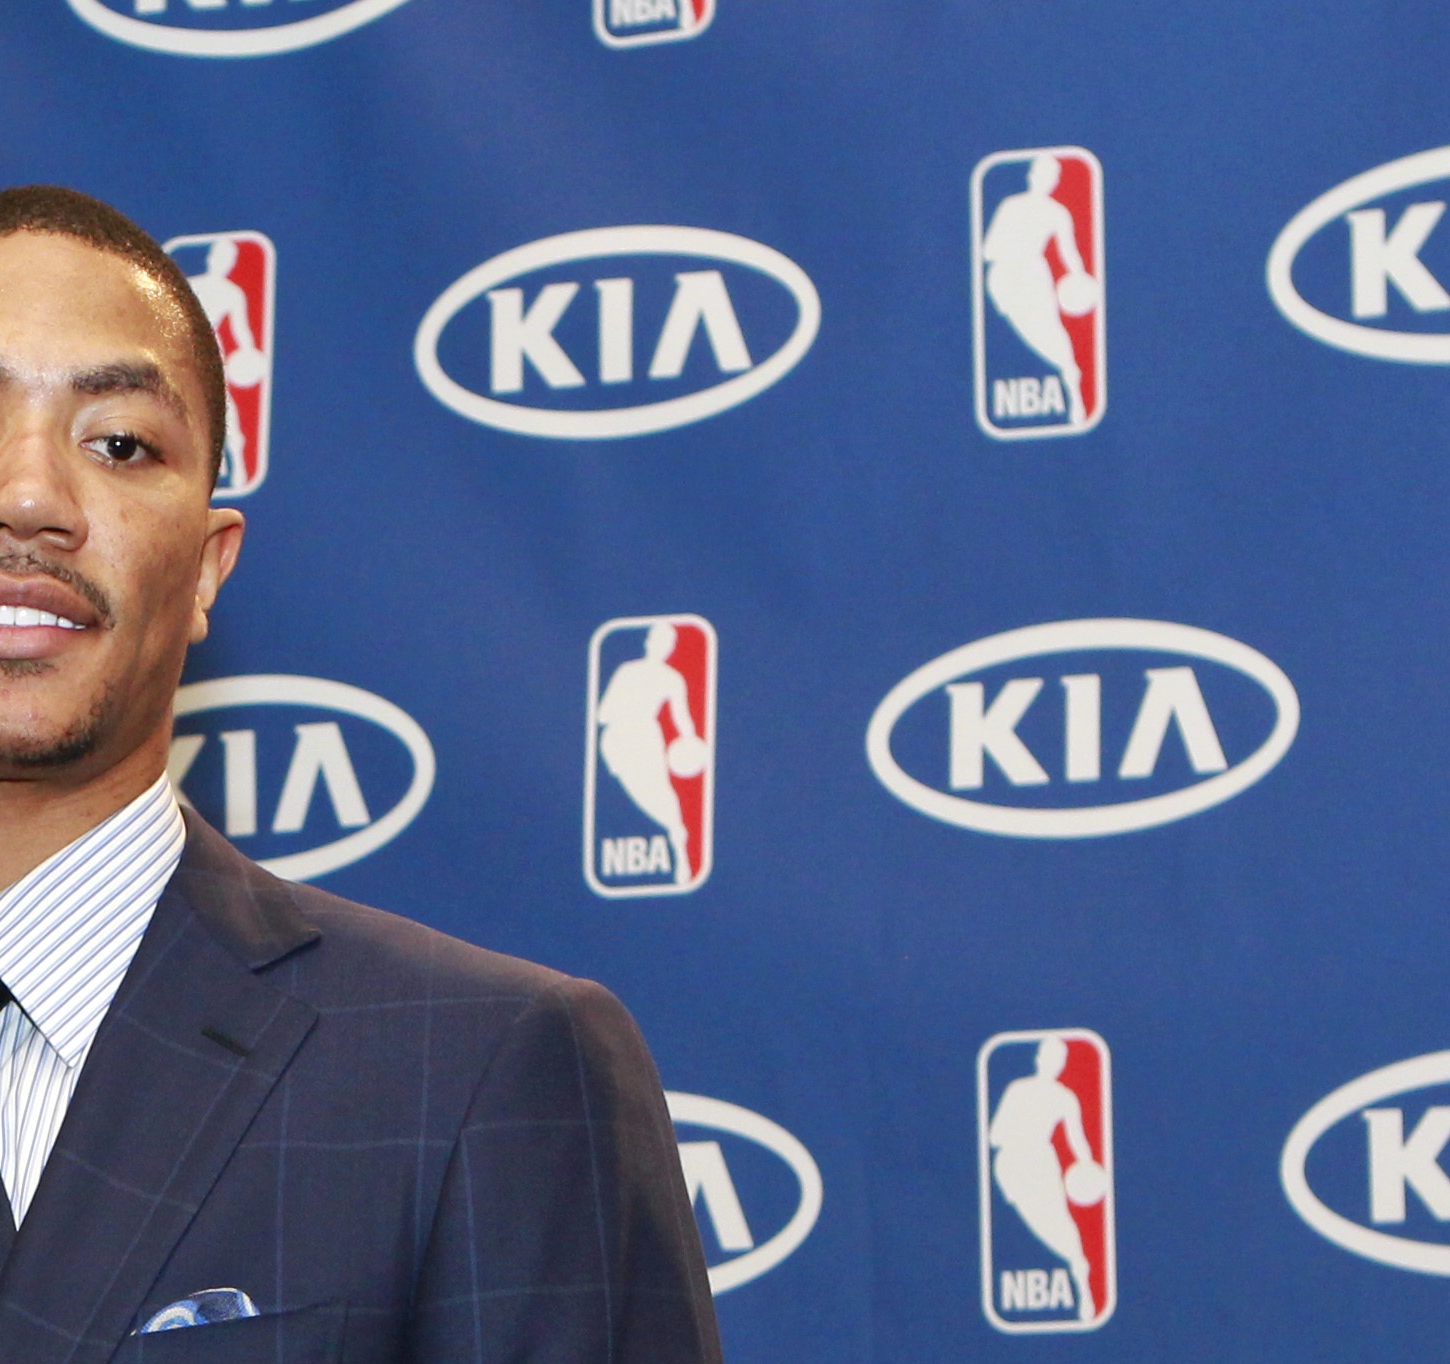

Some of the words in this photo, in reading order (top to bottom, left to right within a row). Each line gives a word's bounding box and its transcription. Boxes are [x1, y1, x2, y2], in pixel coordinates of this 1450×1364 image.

[486, 270, 753, 394] KIA
[993, 376, 1067, 418] NBA
[946, 666, 1229, 790] KIA
[601, 834, 672, 876] NBA
[1000, 1268, 1074, 1311] NBA
